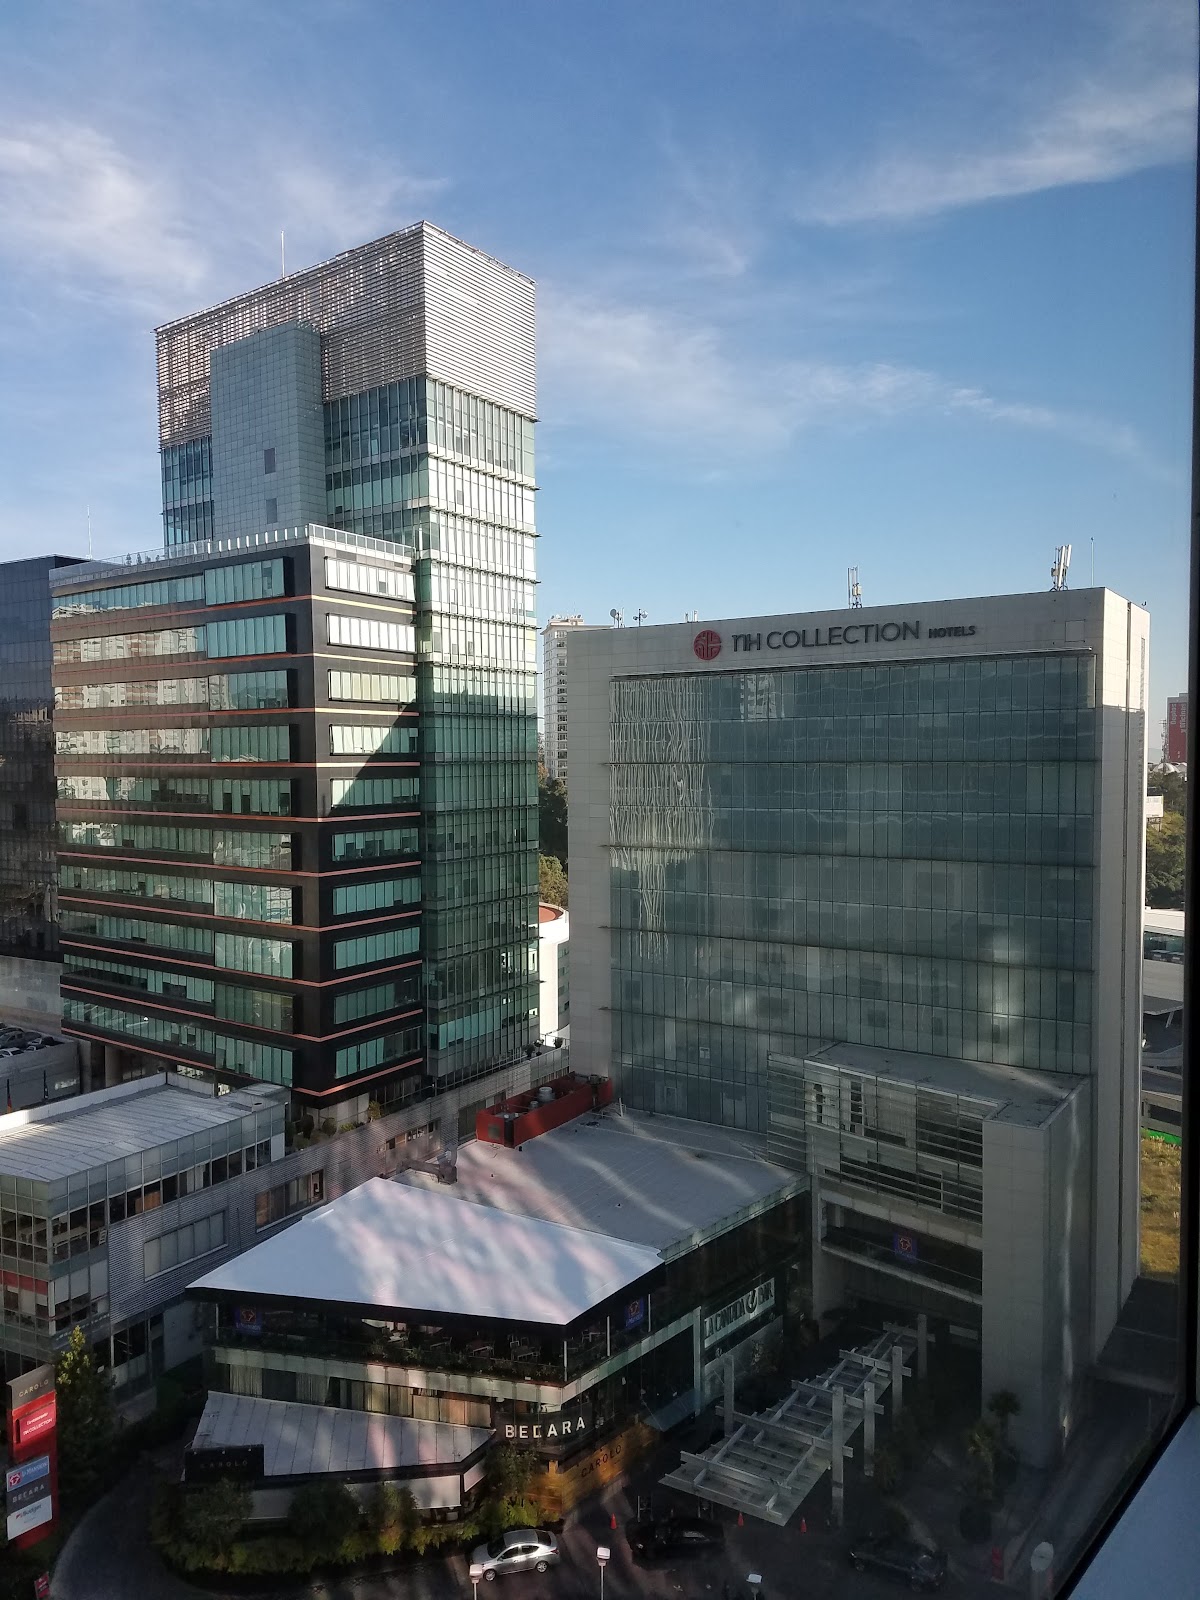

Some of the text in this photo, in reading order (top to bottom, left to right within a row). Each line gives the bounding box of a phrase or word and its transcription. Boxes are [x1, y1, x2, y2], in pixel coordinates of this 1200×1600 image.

[766, 620, 920, 650] COLLECTION
[928, 625, 976, 639] HOTELS
[18, 1379, 49, 1398] CAROLO
[581, 1444, 622, 1478] CAROLO
[12, 1484, 45, 1503] BECARA
